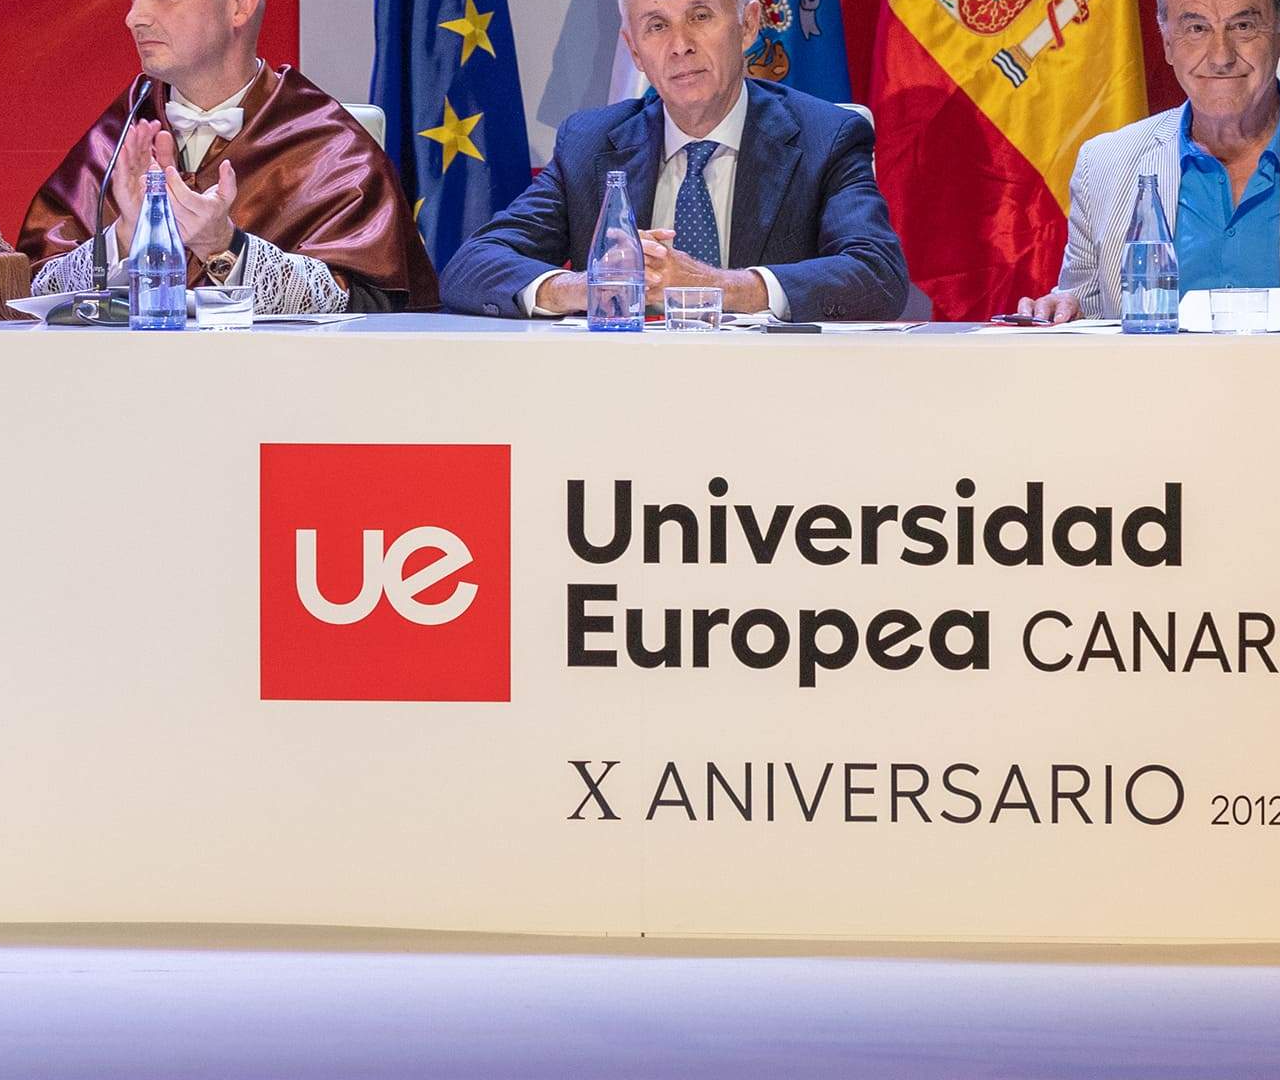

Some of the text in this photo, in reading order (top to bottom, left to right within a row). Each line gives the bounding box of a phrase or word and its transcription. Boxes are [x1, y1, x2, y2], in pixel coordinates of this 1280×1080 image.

[567, 476, 1183, 568] Universidad
[295, 525, 479, 626] ue
[567, 583, 990, 688] Europea
[566, 760, 622, 822] X
[645, 761, 1185, 826] ANIVERSARIO
